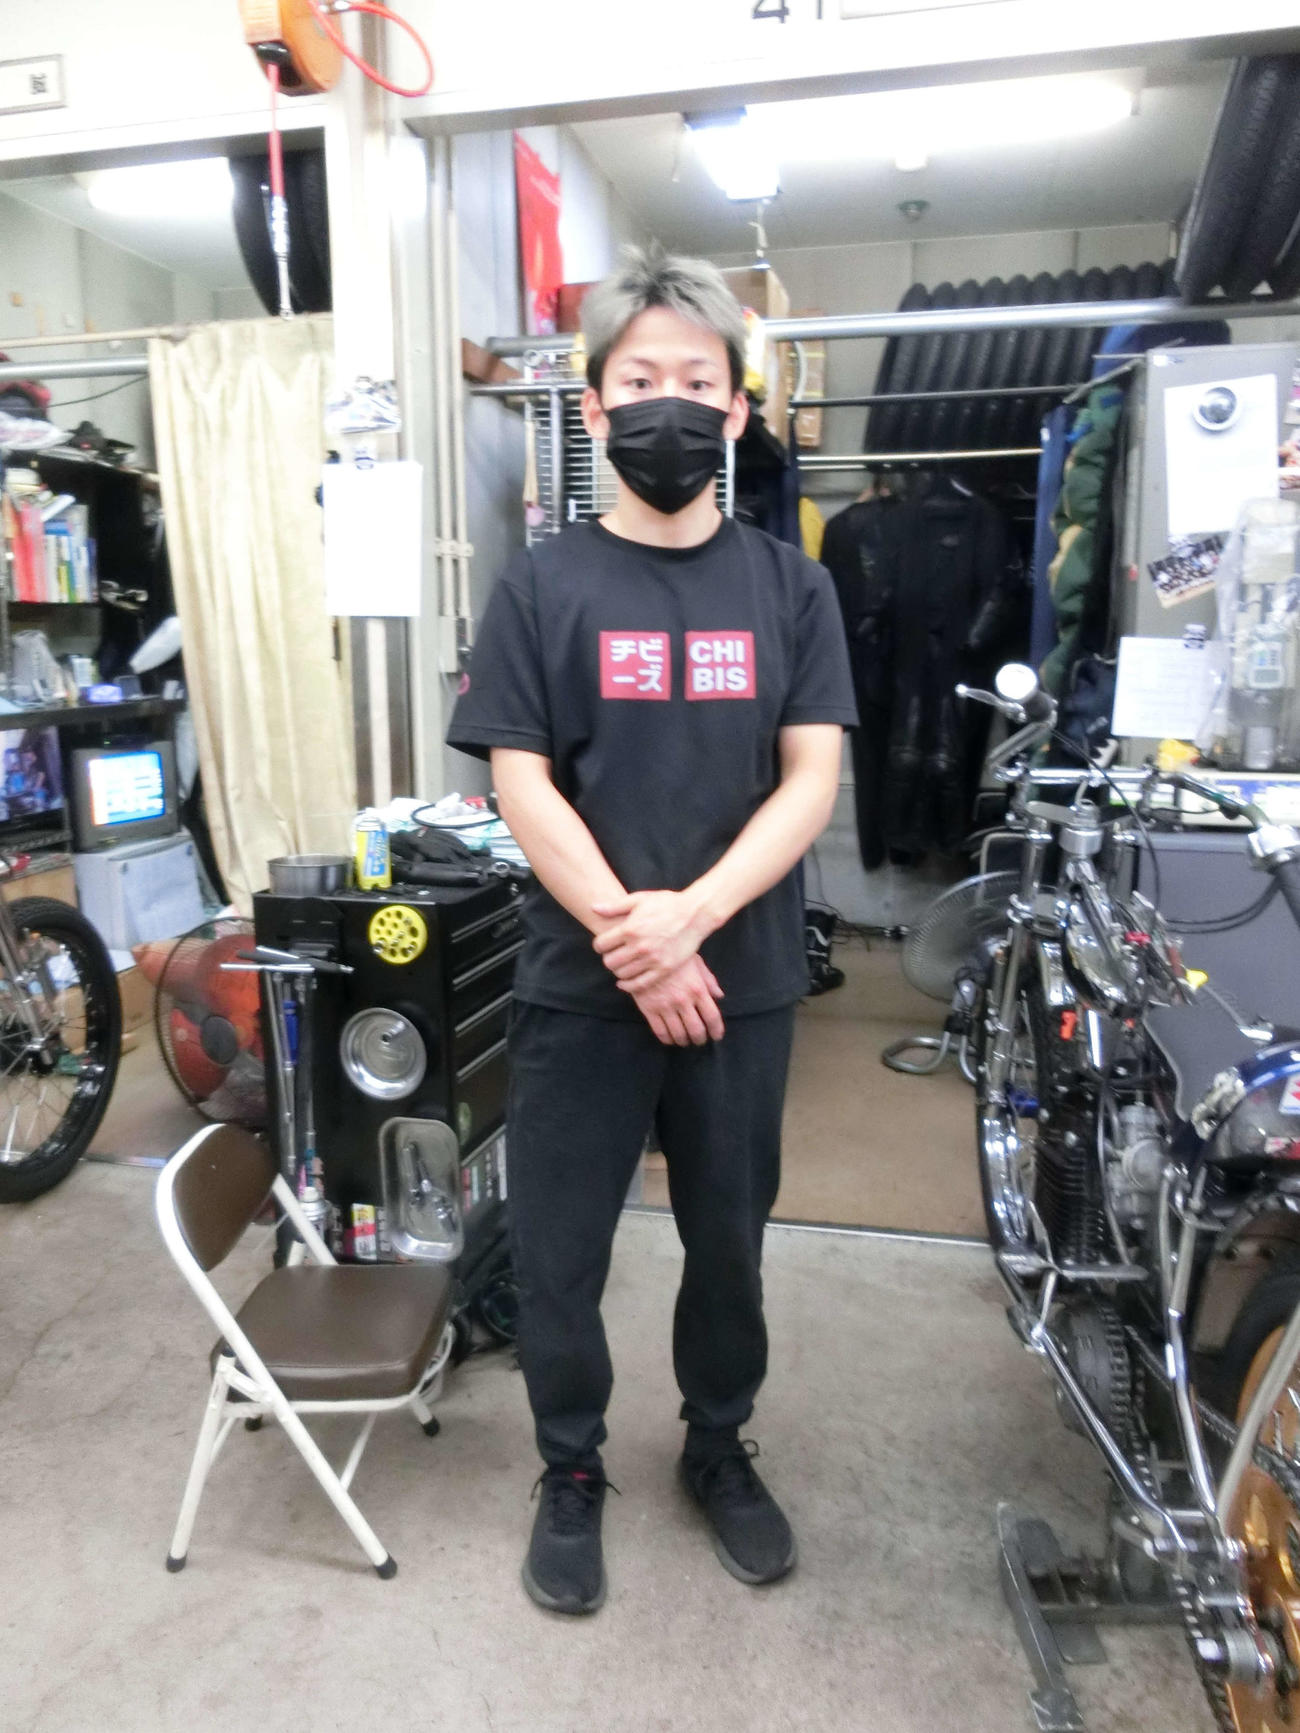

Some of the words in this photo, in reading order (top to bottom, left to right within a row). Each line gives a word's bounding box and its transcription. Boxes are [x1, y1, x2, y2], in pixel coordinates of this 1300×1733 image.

[609, 638, 664, 663] チビ
[689, 639, 746, 664] CHI
[692, 666, 748, 693] BIS
